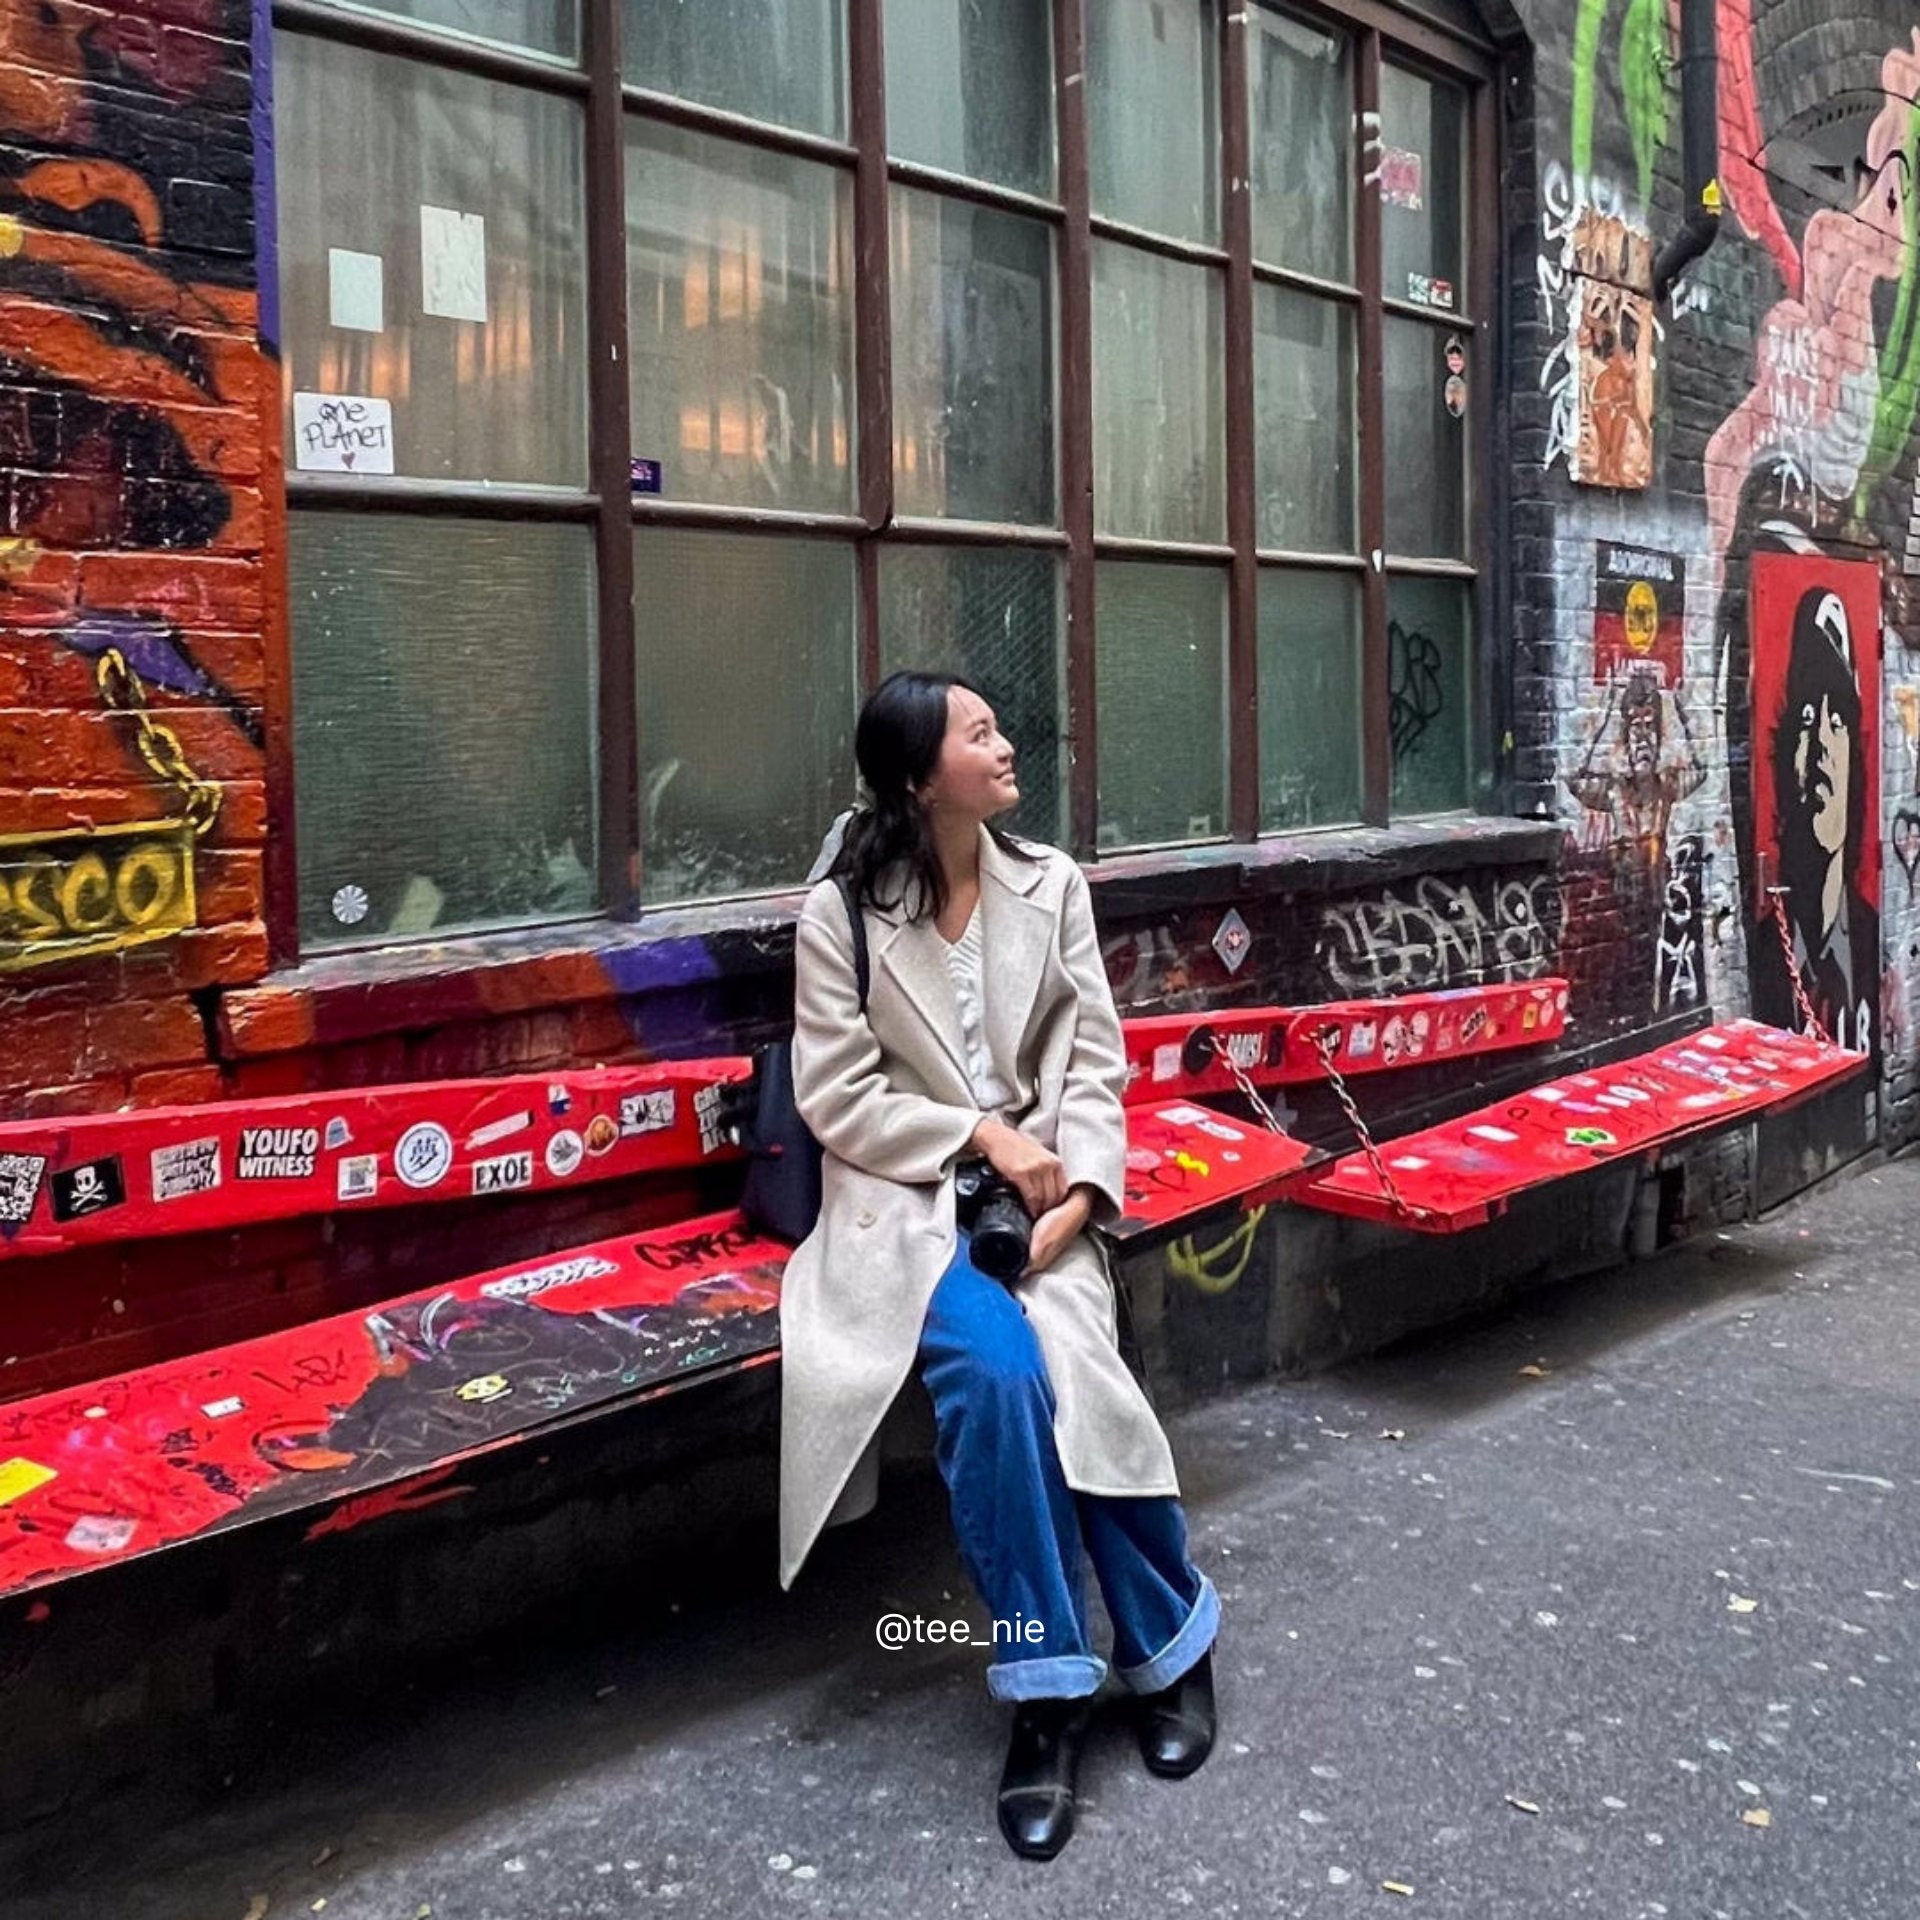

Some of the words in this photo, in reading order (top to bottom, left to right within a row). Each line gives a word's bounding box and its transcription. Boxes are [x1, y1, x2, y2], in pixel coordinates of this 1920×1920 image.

[242, 1128, 318, 1156] YOUFO
[238, 1156, 314, 1178] WITNESS
[475, 1157, 530, 1191] EXOE
